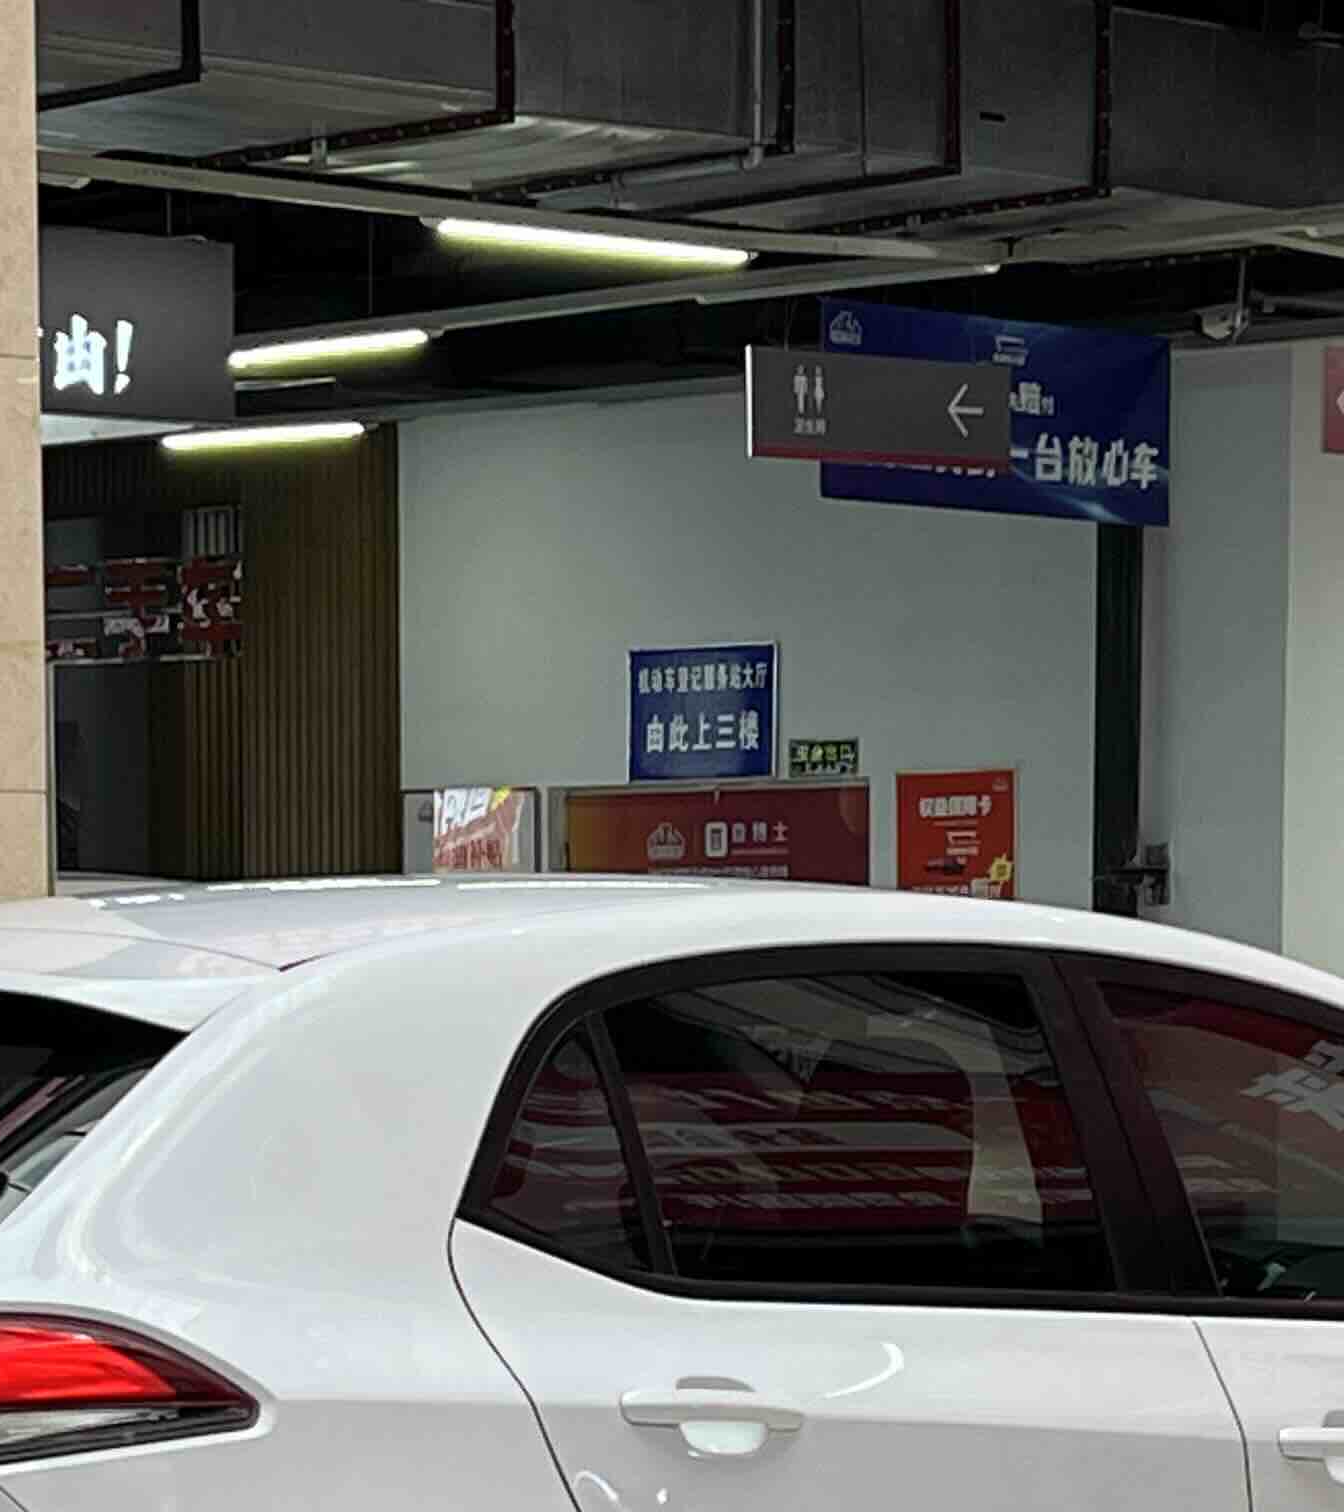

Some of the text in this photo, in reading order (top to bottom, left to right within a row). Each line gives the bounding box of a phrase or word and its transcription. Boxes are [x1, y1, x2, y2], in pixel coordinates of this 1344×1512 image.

[646, 710, 760, 752] 由此上三楼
